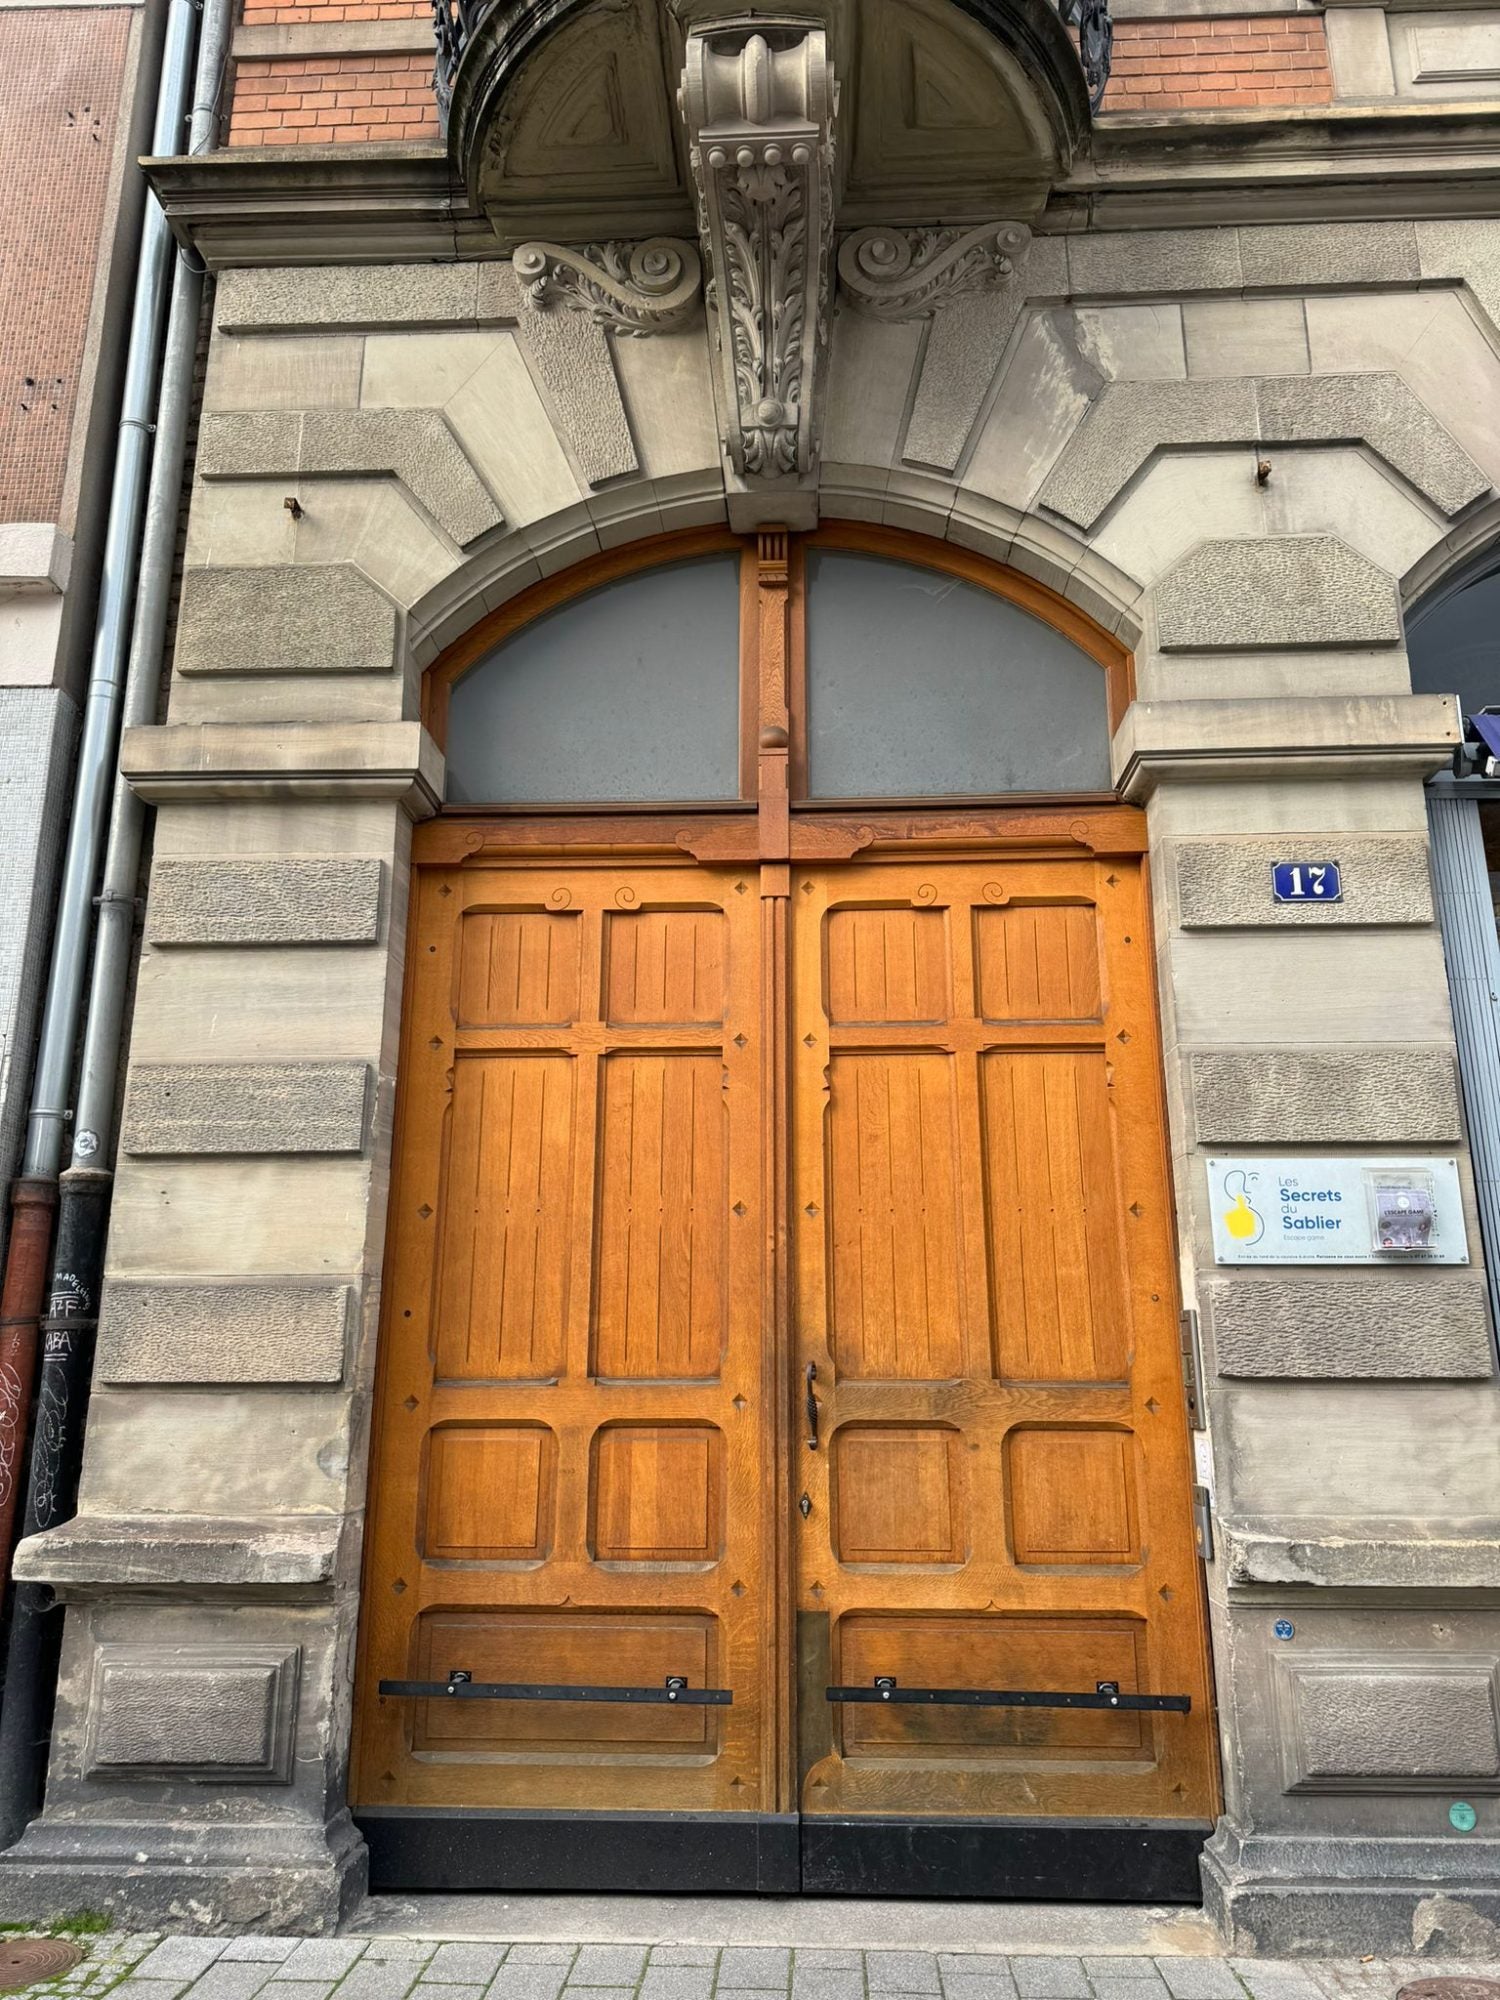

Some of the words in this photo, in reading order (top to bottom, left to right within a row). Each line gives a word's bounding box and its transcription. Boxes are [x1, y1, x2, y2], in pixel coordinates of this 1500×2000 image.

[1289, 867, 1326, 896] 17
[1278, 1176, 1299, 1187] Les
[1280, 1188, 1342, 1202] Secrets
[1281, 1203, 1298, 1214] du
[1282, 1215, 1342, 1230] Sablier
